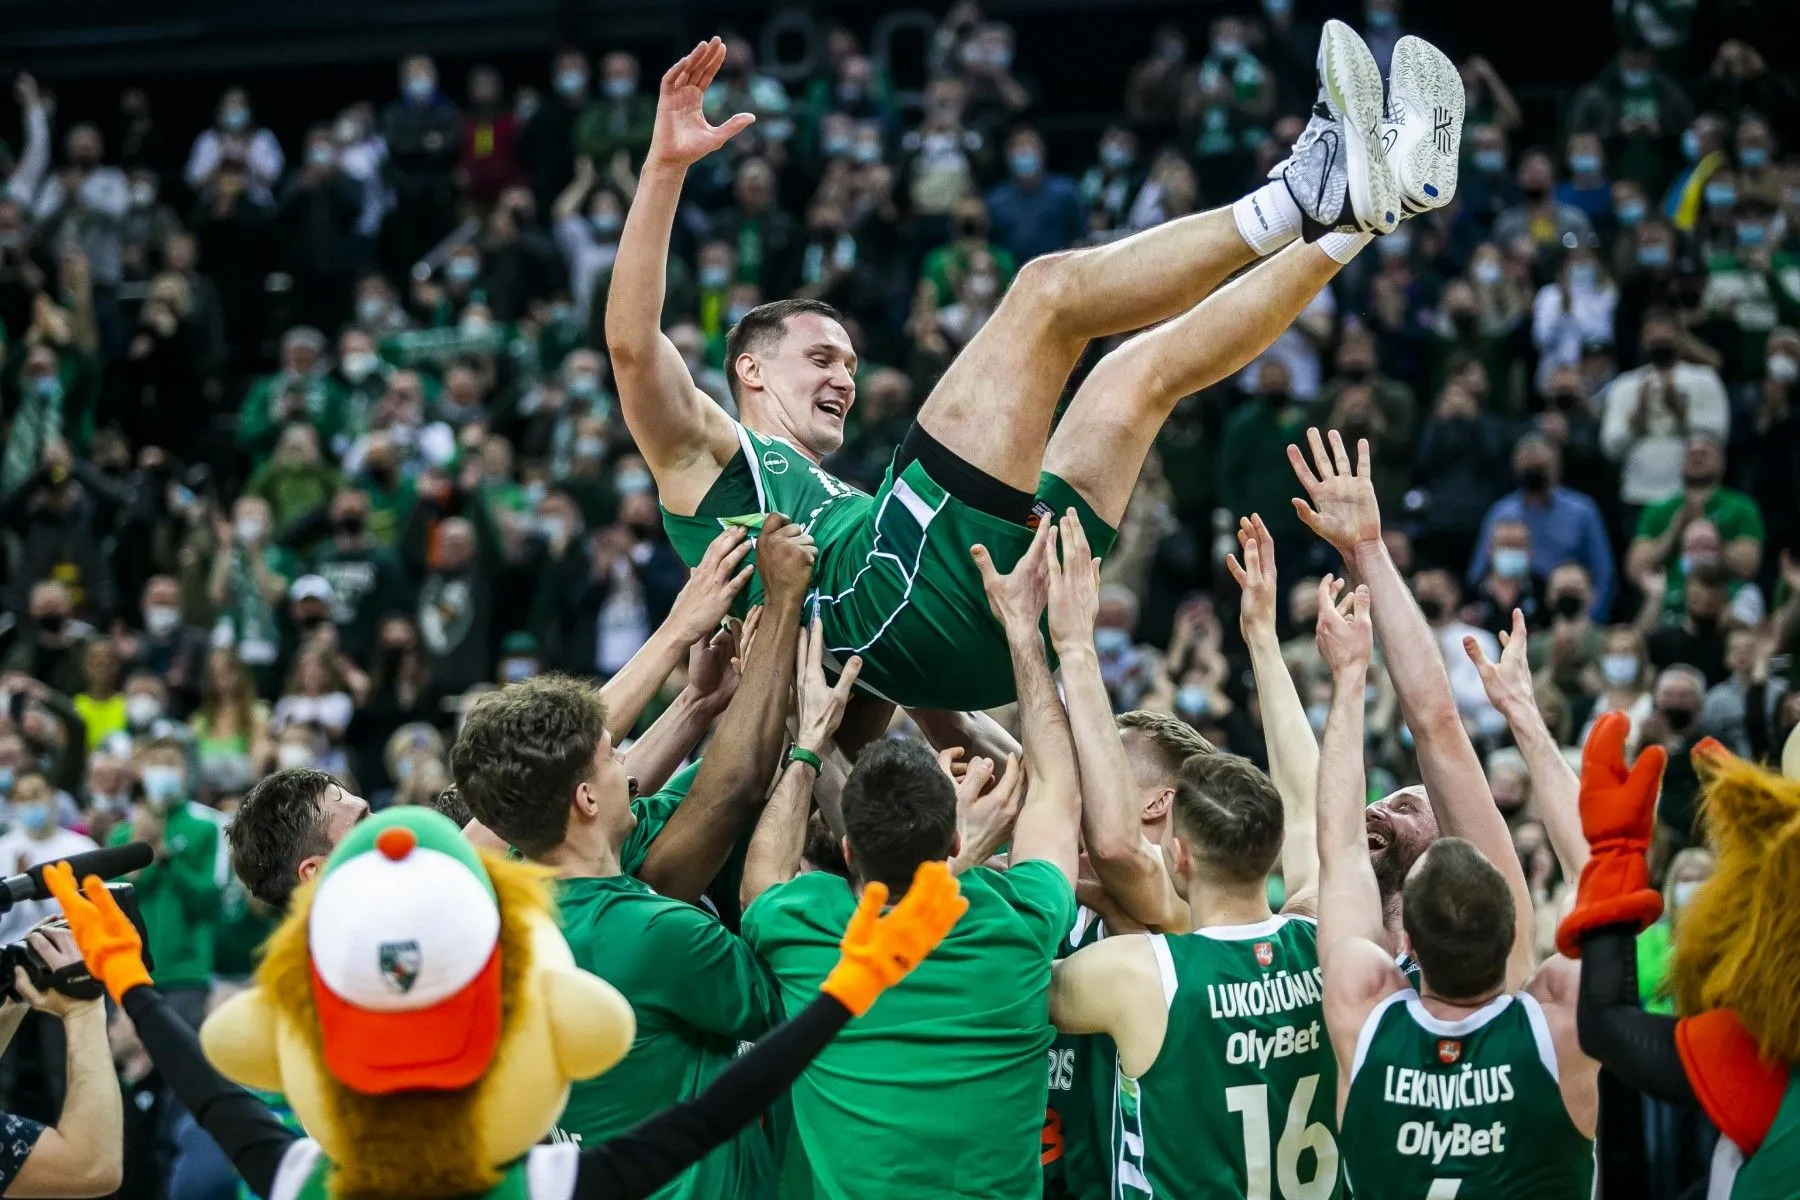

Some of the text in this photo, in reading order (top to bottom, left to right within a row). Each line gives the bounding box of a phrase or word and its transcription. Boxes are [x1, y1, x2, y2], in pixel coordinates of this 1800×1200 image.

[1225, 1019, 1321, 1070] OlyBet
[1384, 1062, 1515, 1111] LEKAVIČIUS
[1225, 1073, 1339, 1200] 16
[1396, 1121, 1506, 1165] OlyBet
